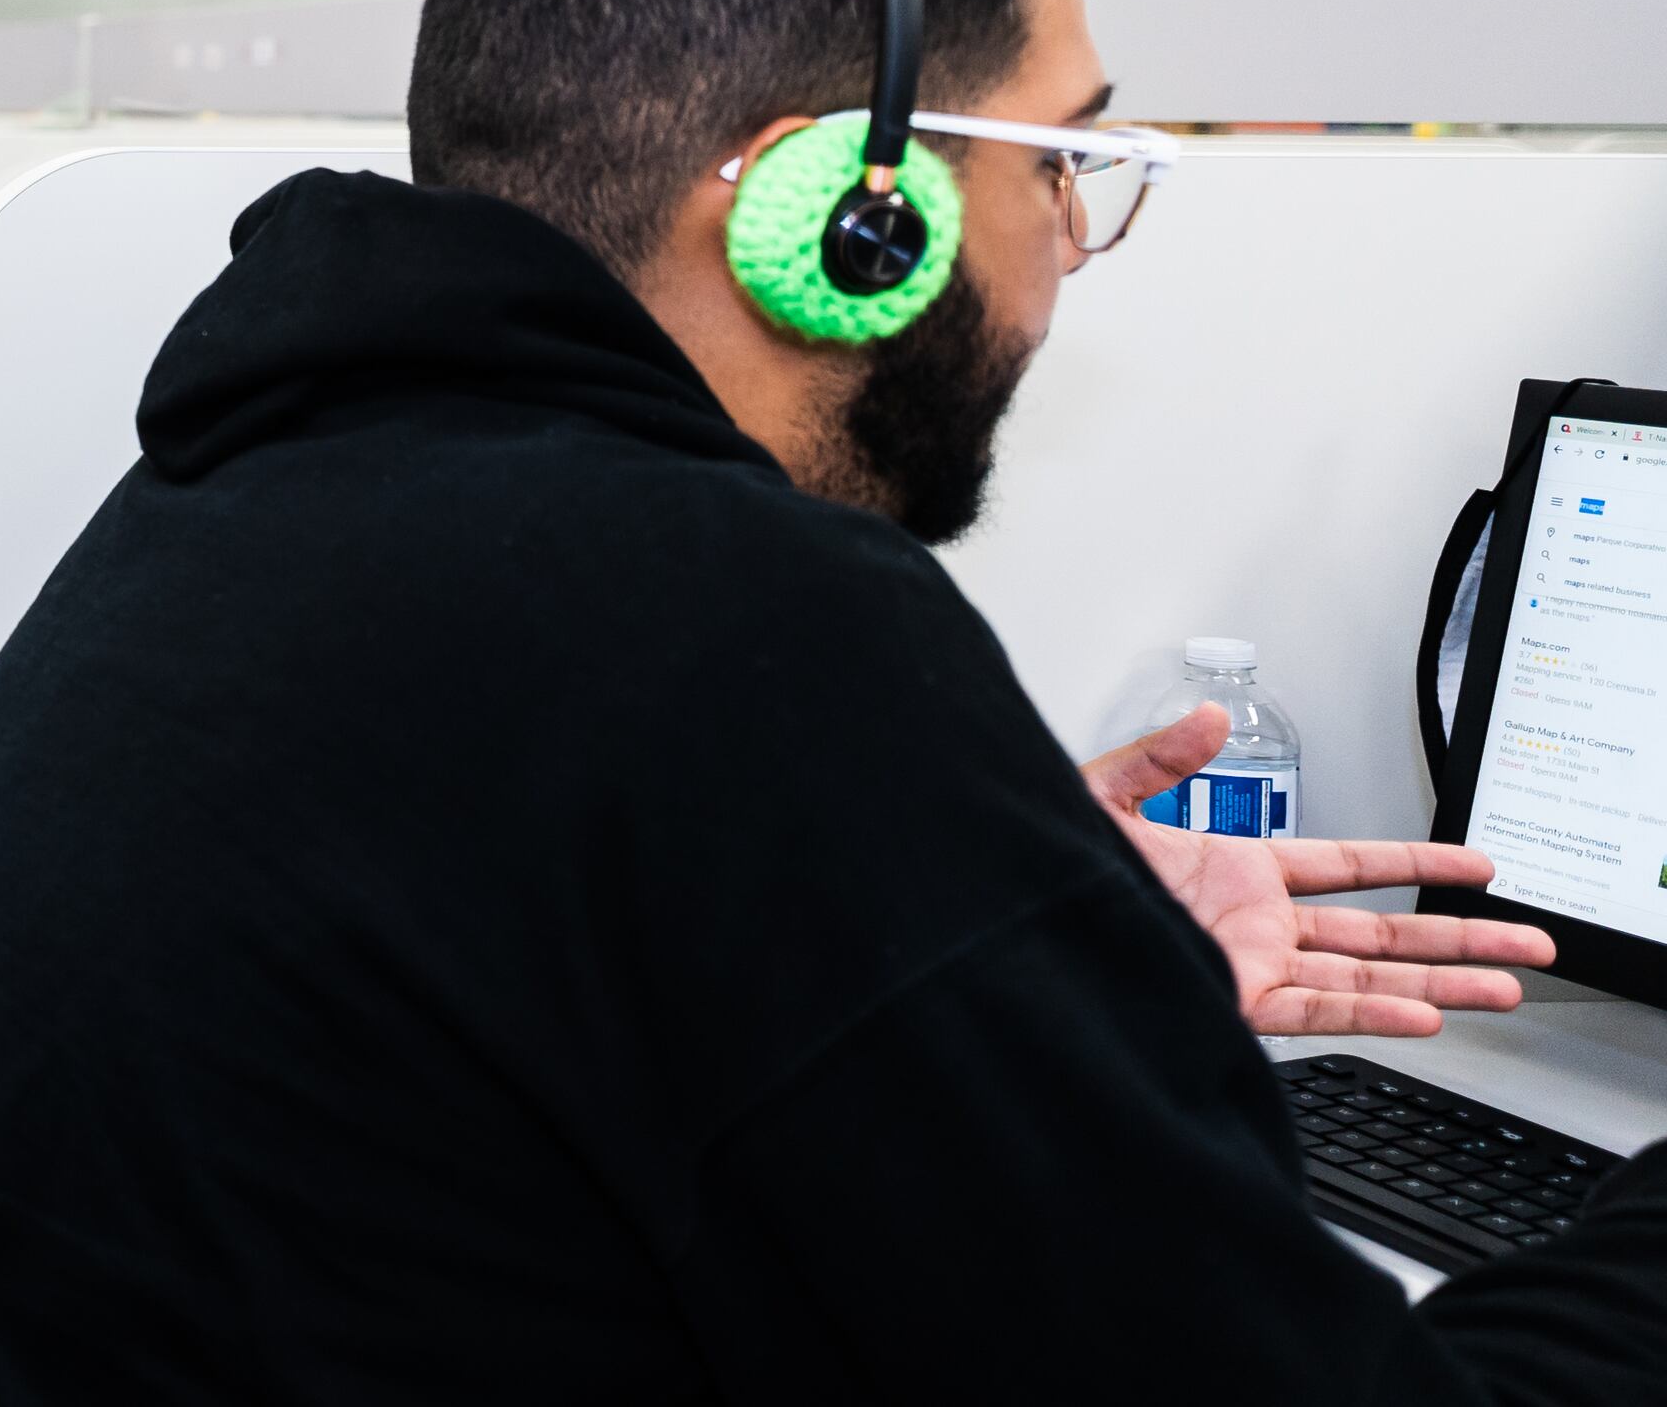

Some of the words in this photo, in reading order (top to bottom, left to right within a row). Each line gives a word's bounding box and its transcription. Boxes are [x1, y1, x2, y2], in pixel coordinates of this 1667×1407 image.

[1573, 533, 1595, 542] maps
[1597, 536, 1622, 547] Parque
[1569, 556, 1591, 565] maps
[1564, 579, 1585, 588] maps
[1587, 582, 1614, 593] related
[1616, 586, 1651, 599] business
[1521, 636, 1571, 654] Maps.com
[1516, 662, 1551, 678] Mapping
[1553, 670, 1583, 682] service
[1511, 687, 1539, 698] Closed
[1545, 694, 1571, 706] Opens
[1573, 700, 1593, 710] 9AM
[1505, 720, 1535, 734] Gallup
[1537, 727, 1557, 739] Map
[1561, 732, 1567, 740] &
[1569, 734, 1585, 745] Art
[1587, 738, 1635, 756] Company
[1497, 758, 1525, 770] Closed
[1531, 766, 1557, 778] Opens
[1559, 772, 1579, 783] 9AM
[1499, 746, 1517, 757] Map
[1519, 750, 1539, 762] store
[1569, 761, 1589, 772] Main
[1525, 784, 1561, 802] shopping
[1601, 804, 1631, 819] pickup
[1485, 811, 1526, 828] Johnson
[1528, 822, 1563, 838] County
[1565, 831, 1621, 852] Automated
[1483, 823, 1539, 844] Information
[1541, 838, 1583, 857] Mapping
[1585, 848, 1622, 866] System
[1516, 858, 1541, 873] results
[1543, 866, 1564, 878] when
[1565, 872, 1583, 884] map
[1585, 877, 1611, 890] moves
[1515, 884, 1533, 897] Type
[1535, 889, 1555, 904] here
[1557, 895, 1567, 906] to
[1569, 900, 1597, 914] search
